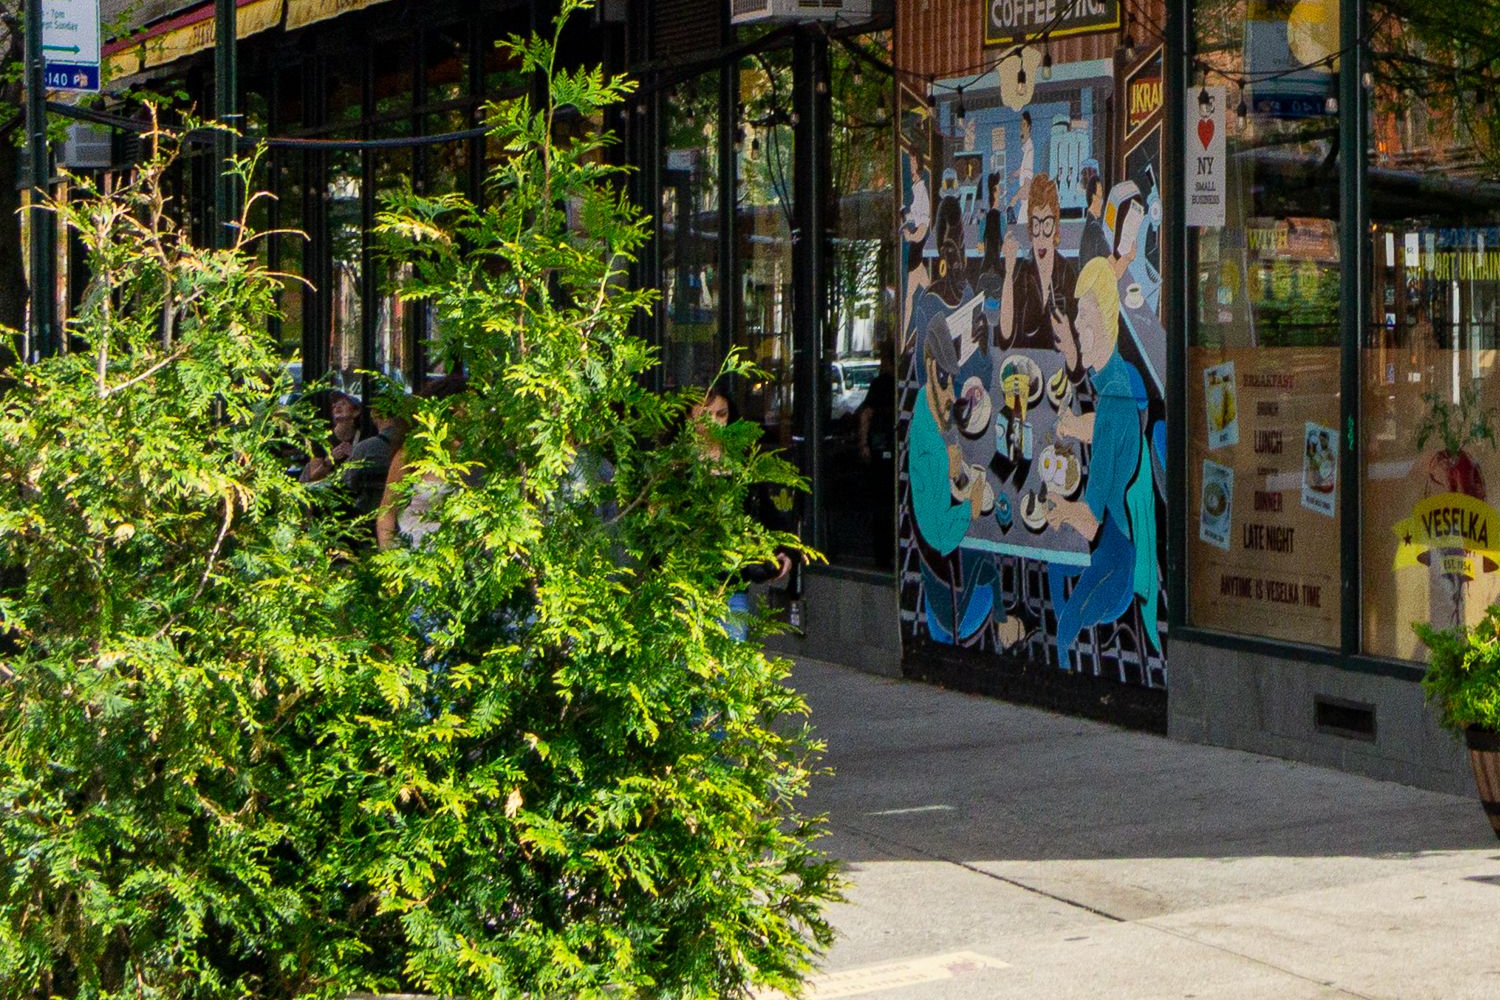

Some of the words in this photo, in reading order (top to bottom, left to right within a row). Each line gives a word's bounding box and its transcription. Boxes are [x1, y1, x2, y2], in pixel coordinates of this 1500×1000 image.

[54, 21, 78, 32] Sunday
[1197, 157, 1214, 174] NY
[1195, 182, 1216, 192] SMALL
[1254, 430, 1282, 454] LUNCH
[1254, 491, 1282, 512] DINNER
[1243, 522, 1264, 550] LATE
[1266, 525, 1294, 553] NIGHT
[1421, 507, 1488, 548] VESELKA
[1220, 575, 1252, 598] ANYTIME
[1256, 579, 1263, 600] IS
[1265, 580, 1299, 604] VESELKA
[1302, 585, 1321, 608] TIME
